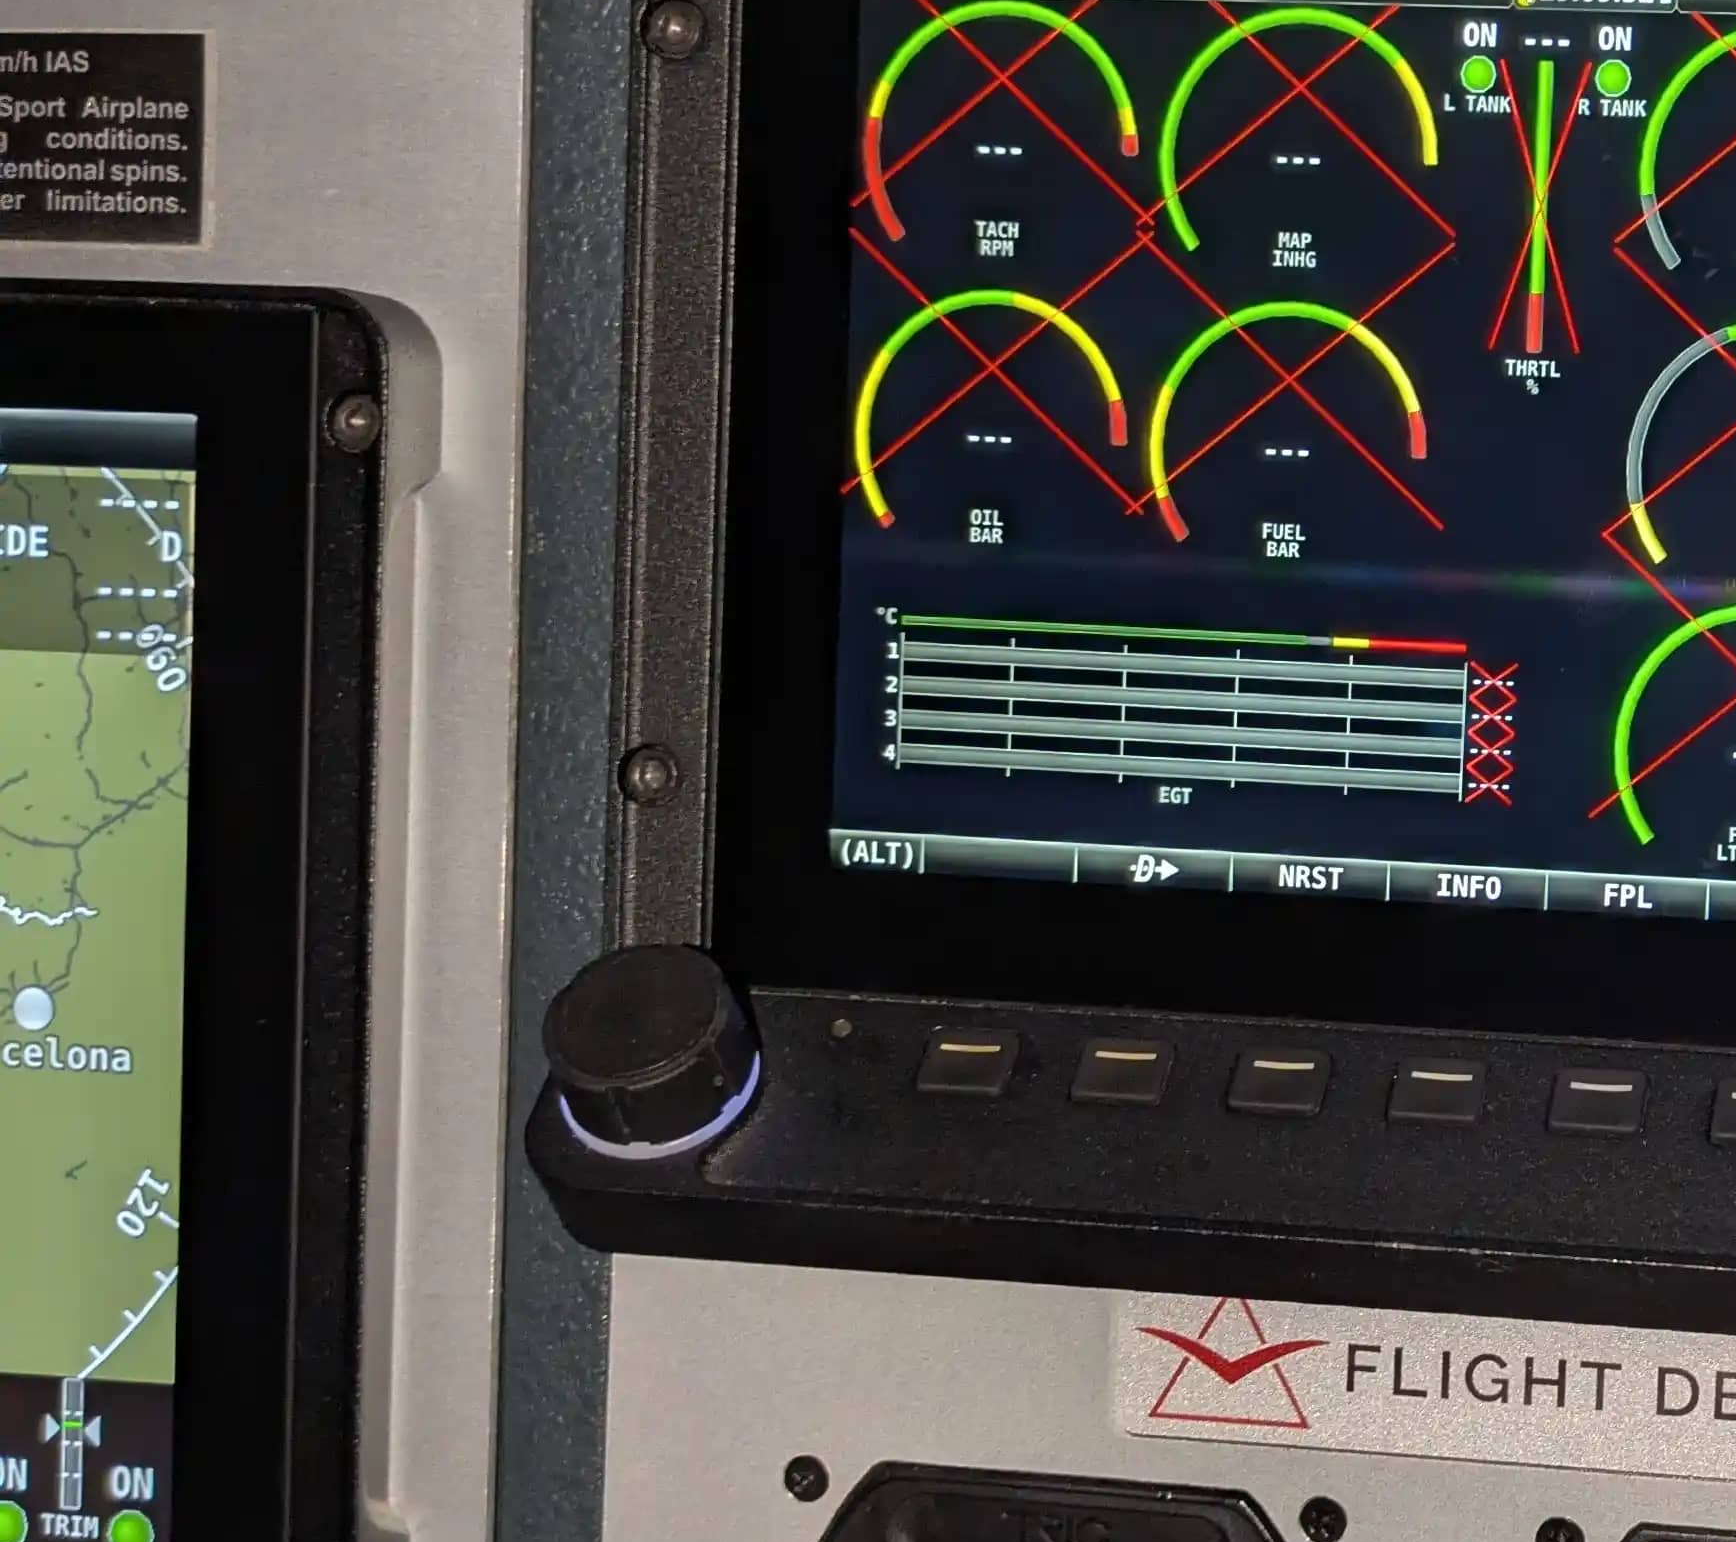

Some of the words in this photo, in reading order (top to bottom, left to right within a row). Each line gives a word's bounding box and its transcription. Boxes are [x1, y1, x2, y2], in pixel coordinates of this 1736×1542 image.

[1463, 24, 1498, 47] ON
[1598, 26, 1633, 52] ON
[46, 51, 90, 73] IAS
[0, 95, 66, 123] Sport
[82, 96, 189, 123] Airplane
[1465, 95, 1512, 113] TANK
[1601, 99, 1647, 118] TANK
[46, 127, 188, 151] conditions.
[110, 161, 187, 186] spins.
[47, 189, 187, 214] limitations.
[975, 221, 1019, 240] TACH
[1278, 232, 1313, 250] MAP
[980, 239, 1014, 257] RPM
[1272, 250, 1317, 269] INHG
[1505, 359, 1561, 379] THRTL
[970, 509, 1004, 527] OIL
[969, 527, 1004, 545] BAR
[1261, 522, 1306, 541] FUEL
[1266, 540, 1300, 559] BAR
[1159, 787, 1191, 804] EGT
[840, 841, 914, 870] (ALT)
[1279, 866, 1343, 892] NRST
[1437, 875, 1501, 902] INFO
[1603, 884, 1653, 910] FPL
[2, 1036, 132, 1072] celona
[1345, 1343, 1622, 1411] FLIGHT
[110, 1466, 155, 1501] ON
[40, 1513, 99, 1540] TRIM
